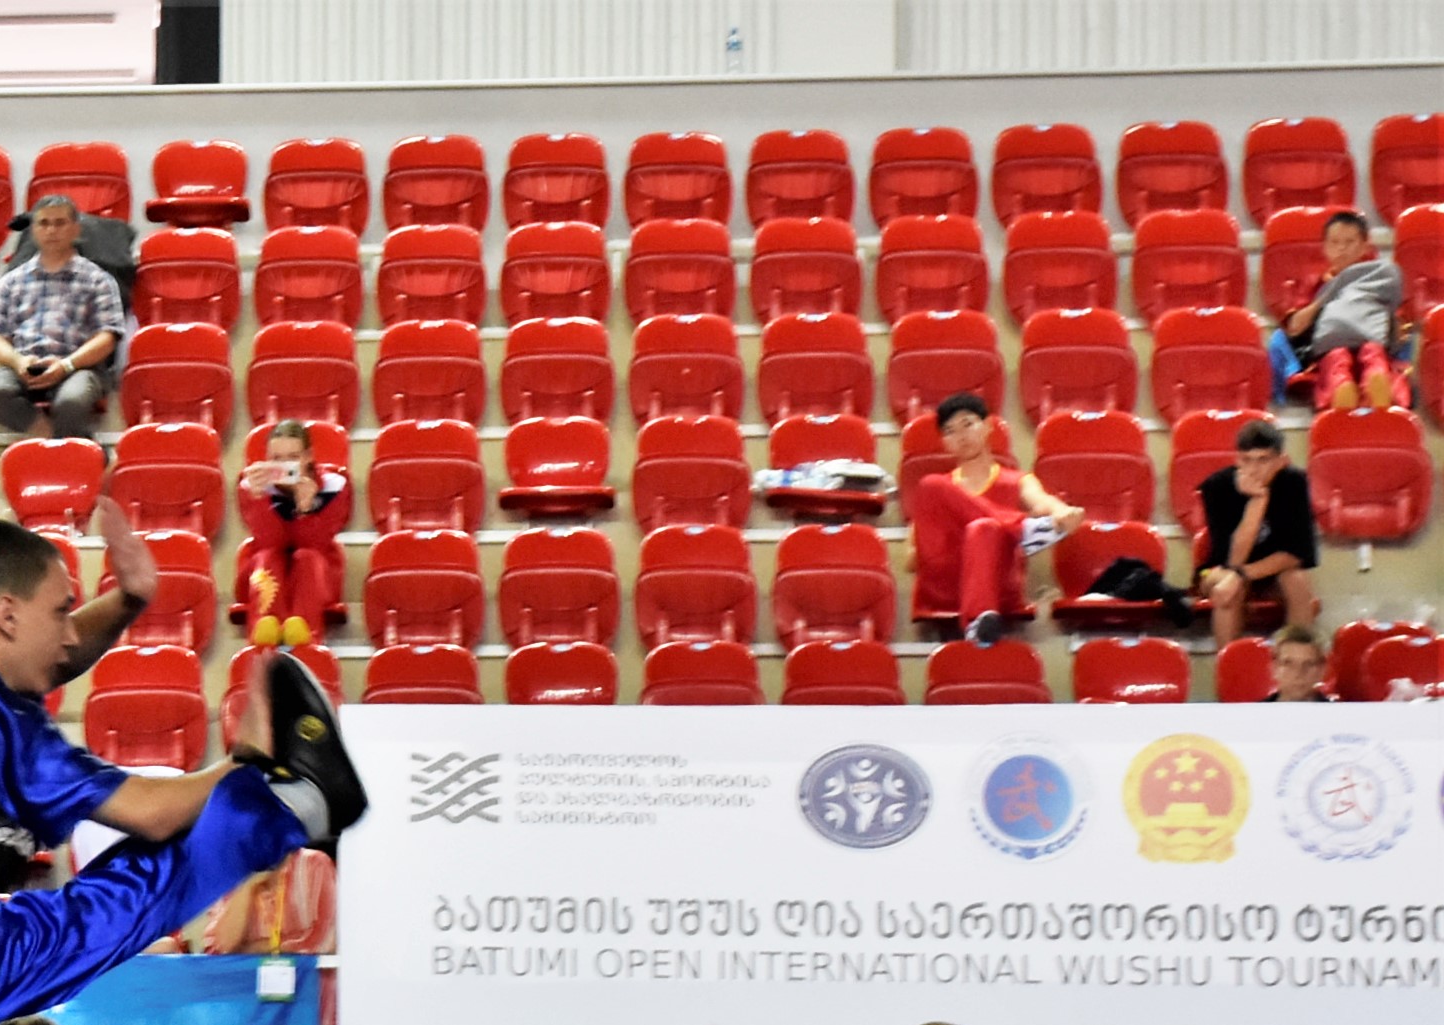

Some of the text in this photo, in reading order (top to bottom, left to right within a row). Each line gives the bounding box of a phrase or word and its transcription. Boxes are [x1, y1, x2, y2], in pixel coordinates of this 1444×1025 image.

[433, 894, 633, 935] ბათუმის
[649, 897, 760, 938] უშუს
[775, 898, 864, 940] ღია
[876, 900, 1279, 943] საერთაშორისო
[432, 946, 579, 977] BATUMI
[595, 948, 702, 980] OPEN
[719, 950, 1043, 984] INTERNATIONAL
[1057, 954, 1214, 987] WUSHU
